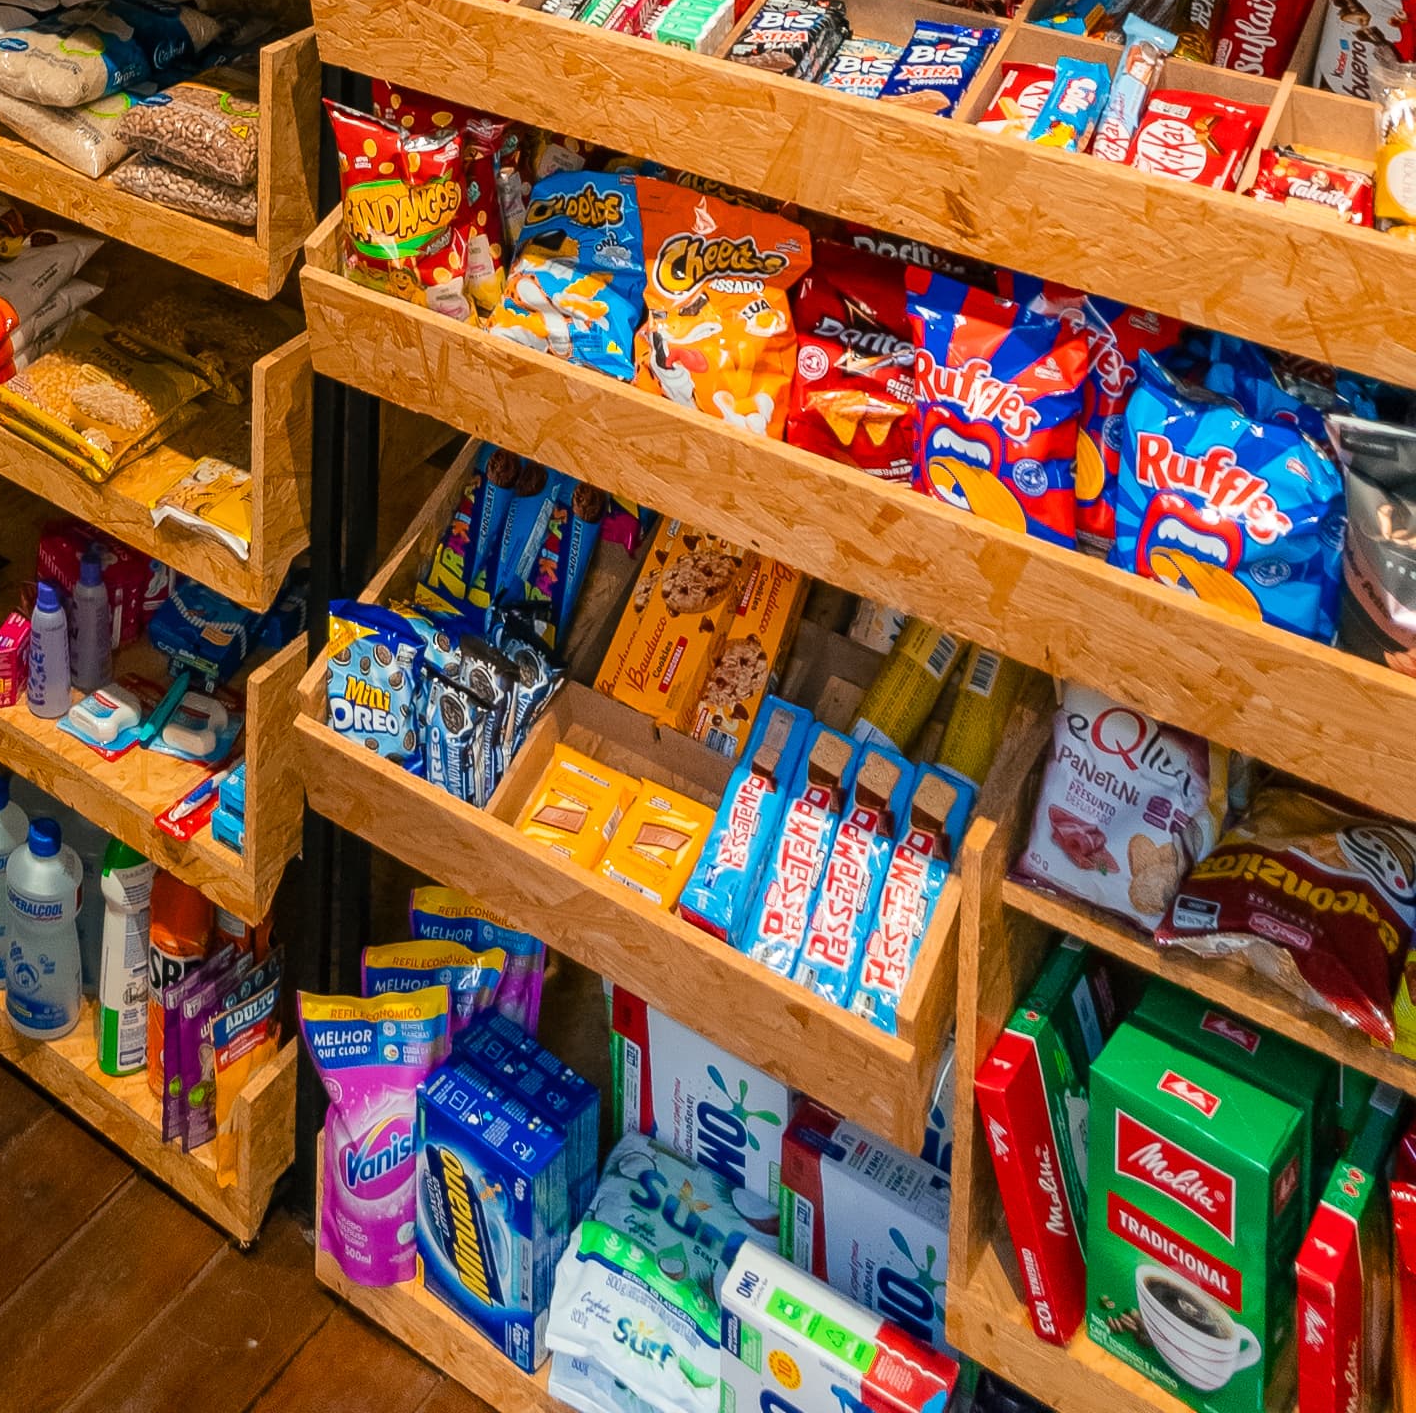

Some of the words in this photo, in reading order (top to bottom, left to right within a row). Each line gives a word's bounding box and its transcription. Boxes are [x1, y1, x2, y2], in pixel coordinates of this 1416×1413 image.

[743, 29, 809, 43] XTRA
[755, 7, 823, 30] BIS
[835, 56, 896, 73] BIS
[895, 65, 963, 79] XTRA
[907, 44, 971, 64] BIS
[1342, 41, 1373, 99] bueno
[830, 75, 888, 87] XTRA
[909, 78, 959, 86] ORIGINAL
[1137, 122, 1206, 180] KitKat
[343, 180, 460, 243] FANDANGOS
[1287, 176, 1352, 213] Talento
[657, 234, 789, 297] Cheetos
[740, 298, 772, 323] LUA
[814, 316, 916, 366] Dorito
[92, 346, 133, 377] PIPOCA
[915, 349, 1041, 443] Ruffles
[1136, 431, 1293, 545] Ruffles
[480, 485, 495, 541] CHOCOLATE
[567, 520, 582, 575] CHOCOLATE
[751, 574, 769, 611] Cookies
[759, 561, 797, 634] Bauducco
[625, 617, 668, 694] Bauducco
[653, 640, 674, 678] Cookies
[346, 676, 391, 711] Mini
[330, 699, 399, 736] OREO
[1068, 781, 1116, 817] PRESUNTO
[419, 924, 473, 942] MELHOR
[392, 956, 419, 967] REFIL
[225, 989, 275, 1033] ADULTO
[330, 1008, 357, 1019] REFIL
[313, 1029, 373, 1046] MELHOR
[317, 1047, 337, 1059] QUE
[345, 1123, 417, 1187] Vanis
[1034, 1141, 1069, 1237] Melitta
[1127, 1140, 1226, 1214] Melitta
[439, 1147, 493, 1307] Minuano
[344, 1245, 372, 1265] 500ml
[1118, 1207, 1232, 1295] TRADICIONAL
[735, 1270, 760, 1299] OMO
[1020, 1247, 1042, 1297] ORIGINAL
[1032, 1299, 1056, 1335] 103
[613, 1316, 676, 1371] Surf
